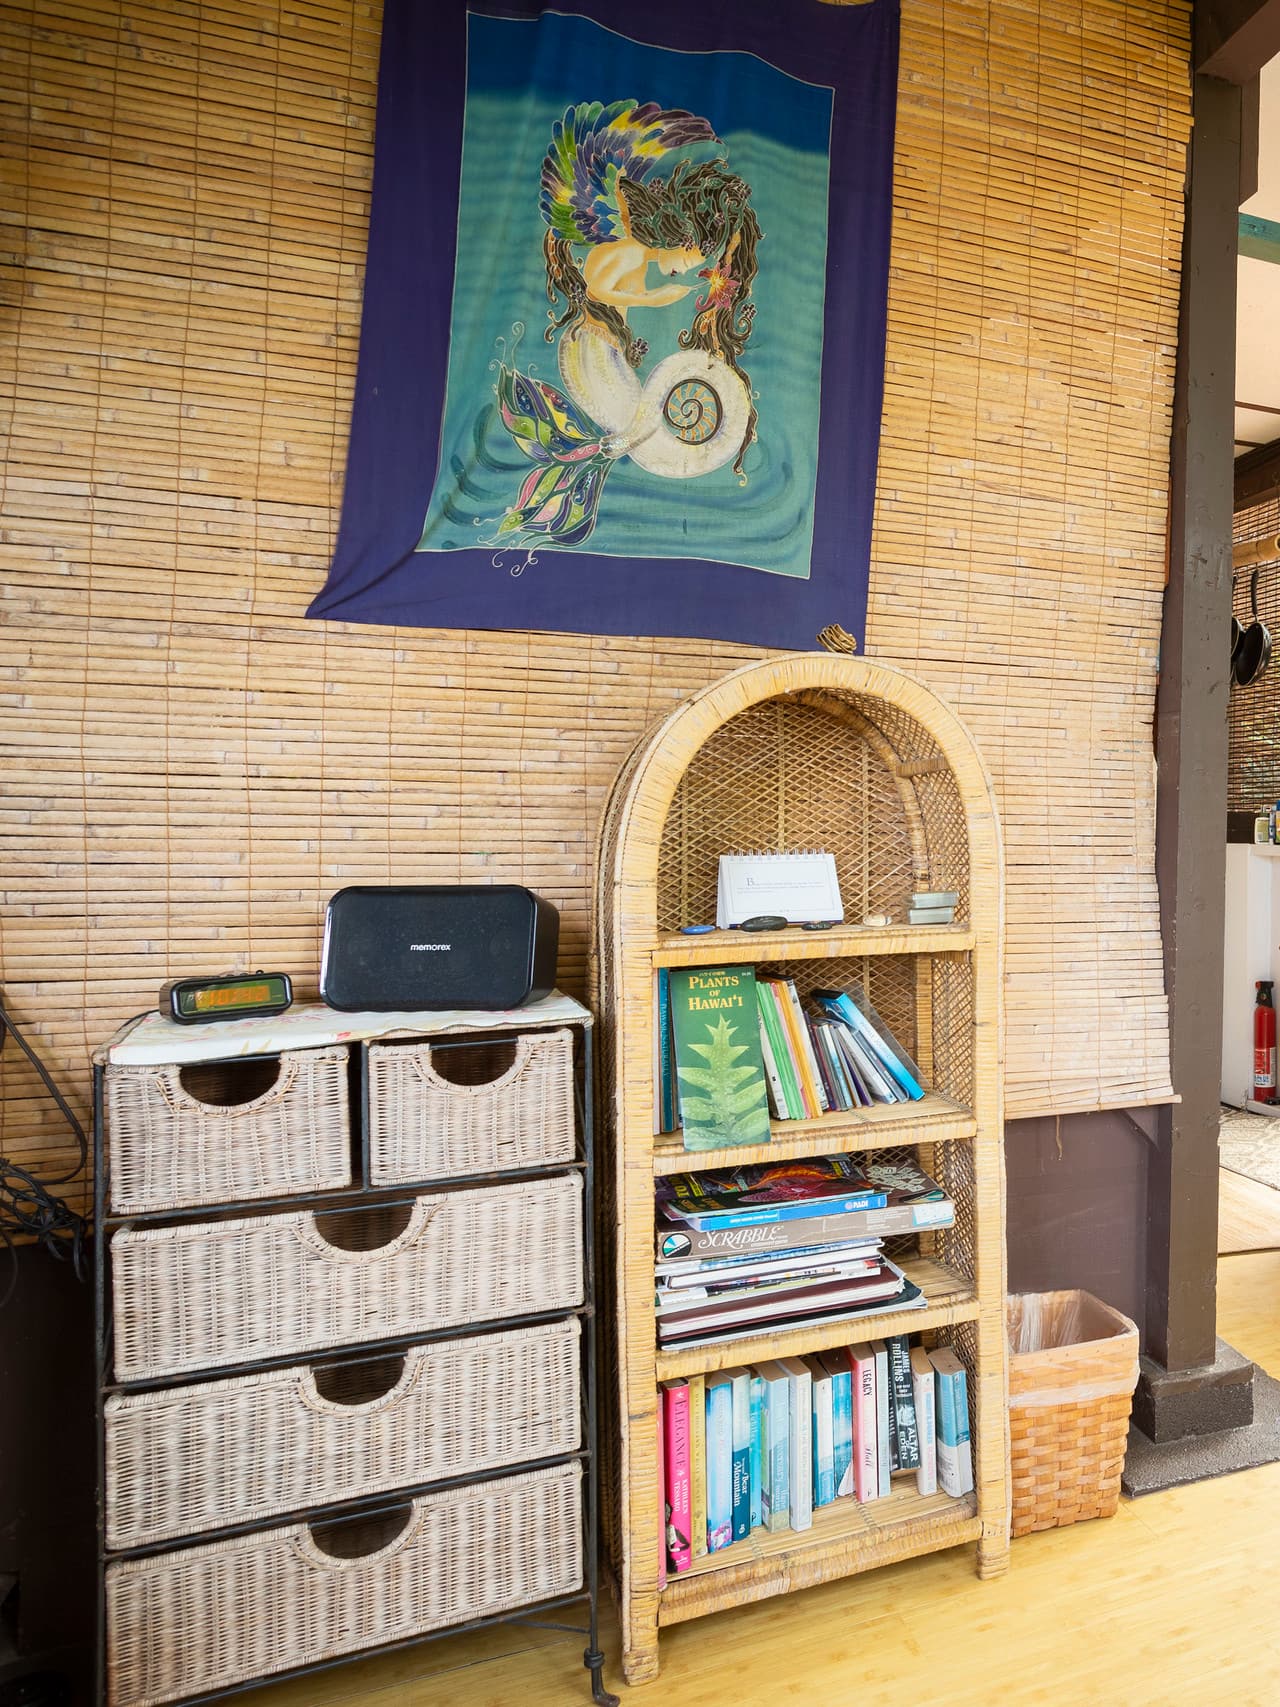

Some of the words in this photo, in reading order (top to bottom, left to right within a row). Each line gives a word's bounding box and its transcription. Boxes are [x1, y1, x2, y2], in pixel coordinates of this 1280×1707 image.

[688, 976, 739, 989] PLANTS
[709, 989, 720, 997] OF
[688, 994, 743, 1010] HAWAI'I
[853, 1200, 868, 1209] PADI
[698, 1225, 780, 1250] SCRABBLE
[892, 1343, 904, 1382] ROLLINS
[902, 1350, 910, 1373] JAMES
[863, 1369, 873, 1396] LEGACY
[675, 1399, 687, 1466] ELEGANCE
[900, 1431, 908, 1460] EDEN
[907, 1427, 919, 1461] ALTAR
[733, 1461, 742, 1507] Mountain
